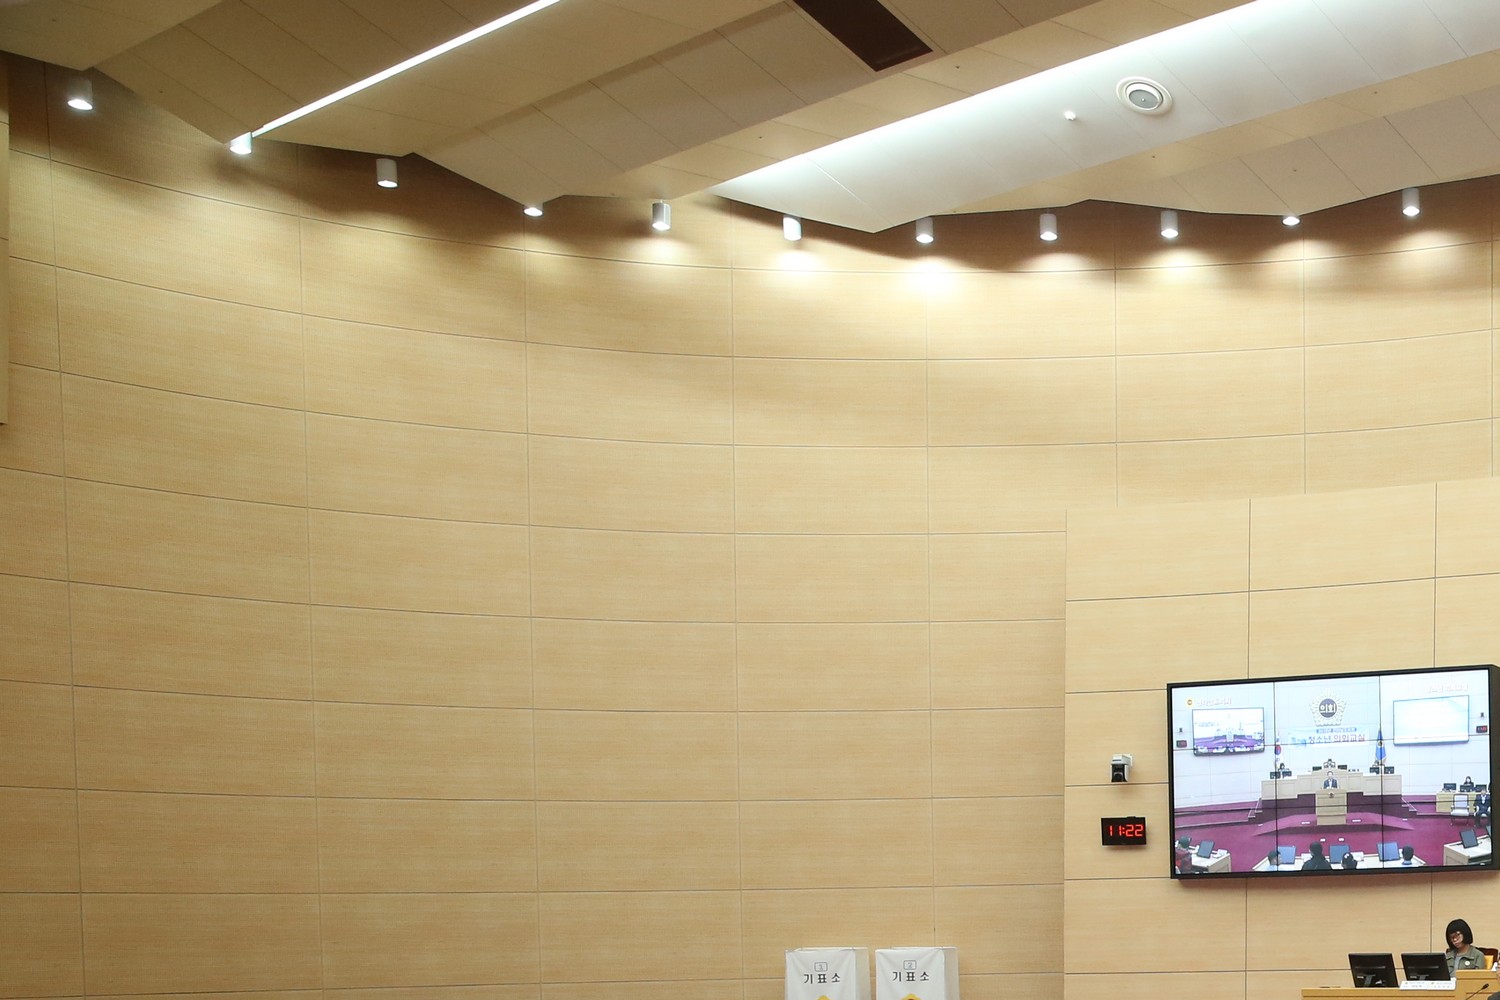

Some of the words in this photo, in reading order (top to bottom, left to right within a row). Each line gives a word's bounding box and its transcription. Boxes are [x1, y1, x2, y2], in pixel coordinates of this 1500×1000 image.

[1109, 824, 1144, 837] 11:22
[803, 973, 840, 984] 기표소
[892, 971, 929, 982] 기표소
